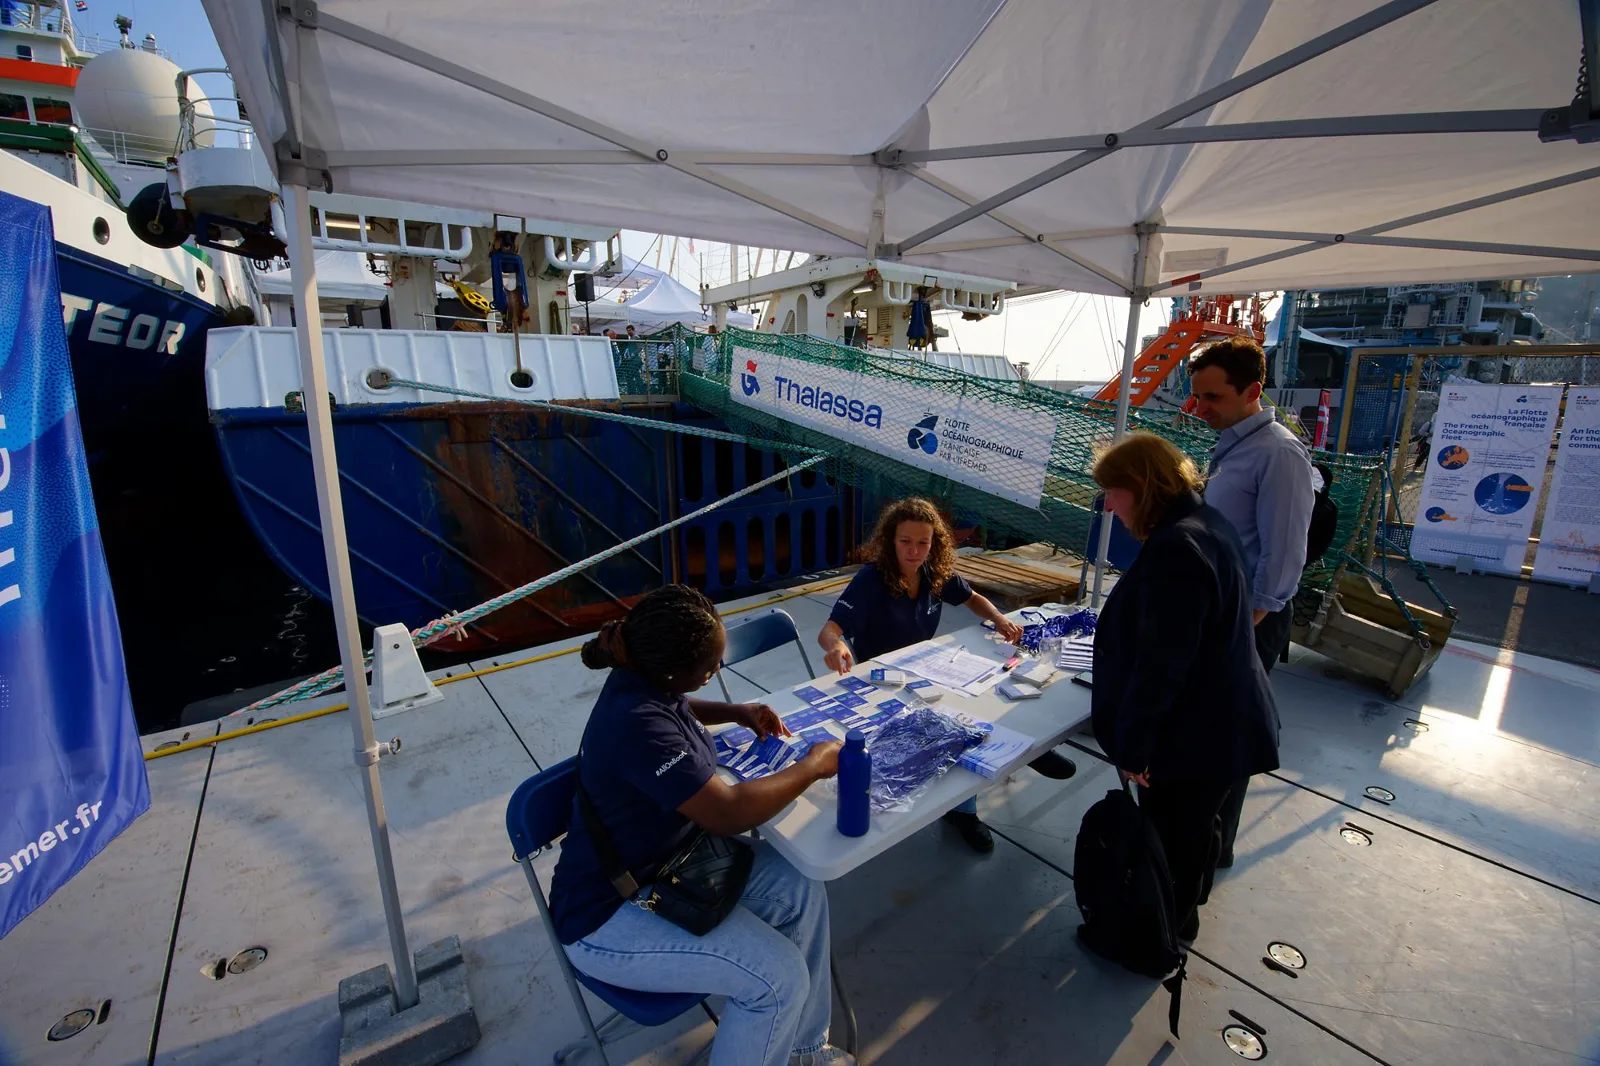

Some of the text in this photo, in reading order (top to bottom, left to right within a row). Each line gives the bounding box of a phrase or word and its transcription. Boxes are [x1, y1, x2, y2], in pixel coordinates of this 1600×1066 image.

[774, 376, 883, 429] Thalassa
[1471, 412, 1547, 423] océanographique
[944, 417, 971, 432] FLOTTE
[1504, 420, 1546, 429] française
[1442, 428, 1506, 438] Oceanographic
[942, 429, 1024, 460] OCÉANOGRAPHIQUE
[939, 450, 952, 461] PAR
[0, 800, 103, 885] emer.fr
